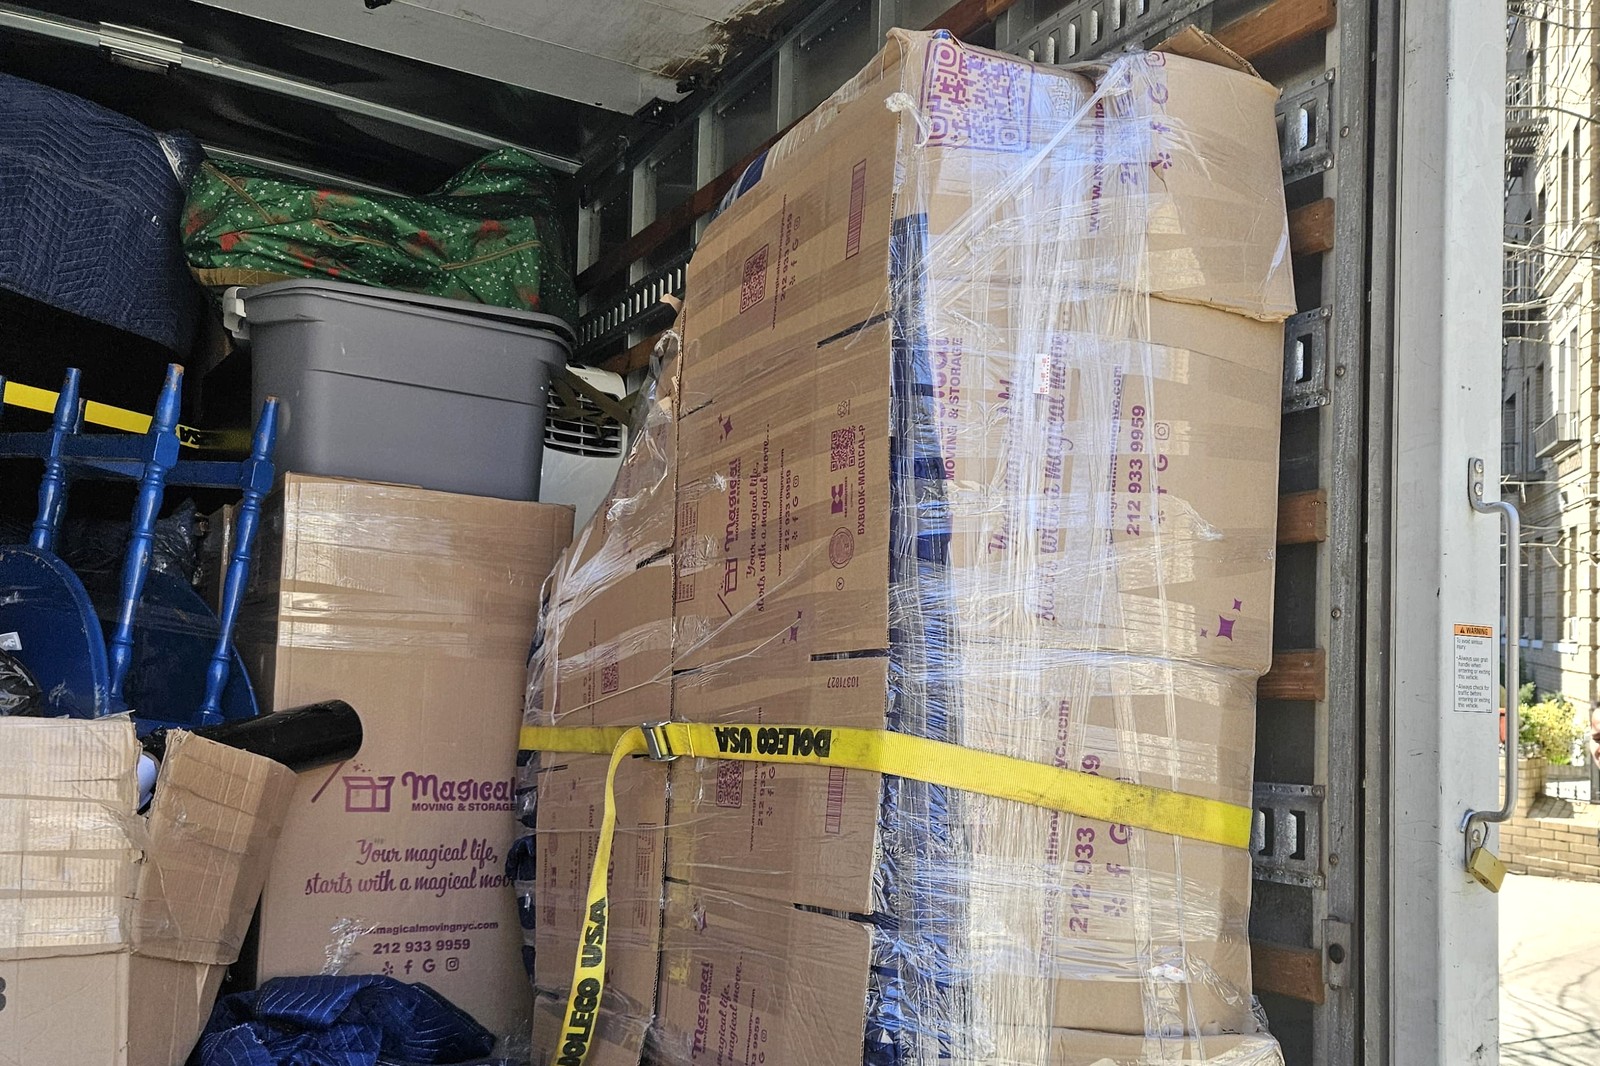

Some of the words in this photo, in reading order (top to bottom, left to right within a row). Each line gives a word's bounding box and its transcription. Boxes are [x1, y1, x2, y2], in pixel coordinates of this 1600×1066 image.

[949, 337, 963, 401] STORAGE
[1044, 388, 1074, 480] magical
[1130, 405, 1145, 452] 9959
[944, 427, 957, 482] MOVING
[749, 462, 761, 487] life,
[858, 425, 866, 535] BXBOOK-MAGICAL-P
[1128, 458, 1143, 494] 933
[724, 459, 738, 552] Magical
[749, 489, 760, 540] magical
[760, 476, 770, 527] magical
[1126, 500, 1141, 536] 212
[761, 529, 766, 539] a
[745, 542, 756, 579] Your
[758, 541, 766, 572] with
[757, 576, 766, 612] starts
[1466, 627, 1488, 635] WARNING
[826, 676, 860, 689] 10371827
[714, 727, 752, 753] USA
[757, 728, 832, 757] DOLECO
[401, 771, 516, 803] Magical
[412, 802, 453, 812] MOVING
[457, 802, 466, 812] &
[468, 802, 516, 812] STORAGE
[356, 838, 402, 865] Your
[405, 839, 469, 869] magical
[470, 838, 498, 868] life,
[1073, 827, 1095, 876] 933
[305, 871, 352, 895] starts
[358, 869, 394, 893] with
[400, 880, 411, 891] a
[415, 866, 477, 897] magical
[480, 874, 517, 889] mov
[1069, 883, 1090, 934] 212
[350, 921, 499, 936] .magicalmovingnyc.com
[581, 897, 606, 968] USA
[373, 942, 403, 955] 212
[405, 940, 432, 953] 933
[435, 939, 471, 952] 9959
[692, 961, 711, 1059] Magical
[720, 984, 731, 1008] life,
[716, 1009, 728, 1066] magical
[727, 1004, 738, 1062] magical
